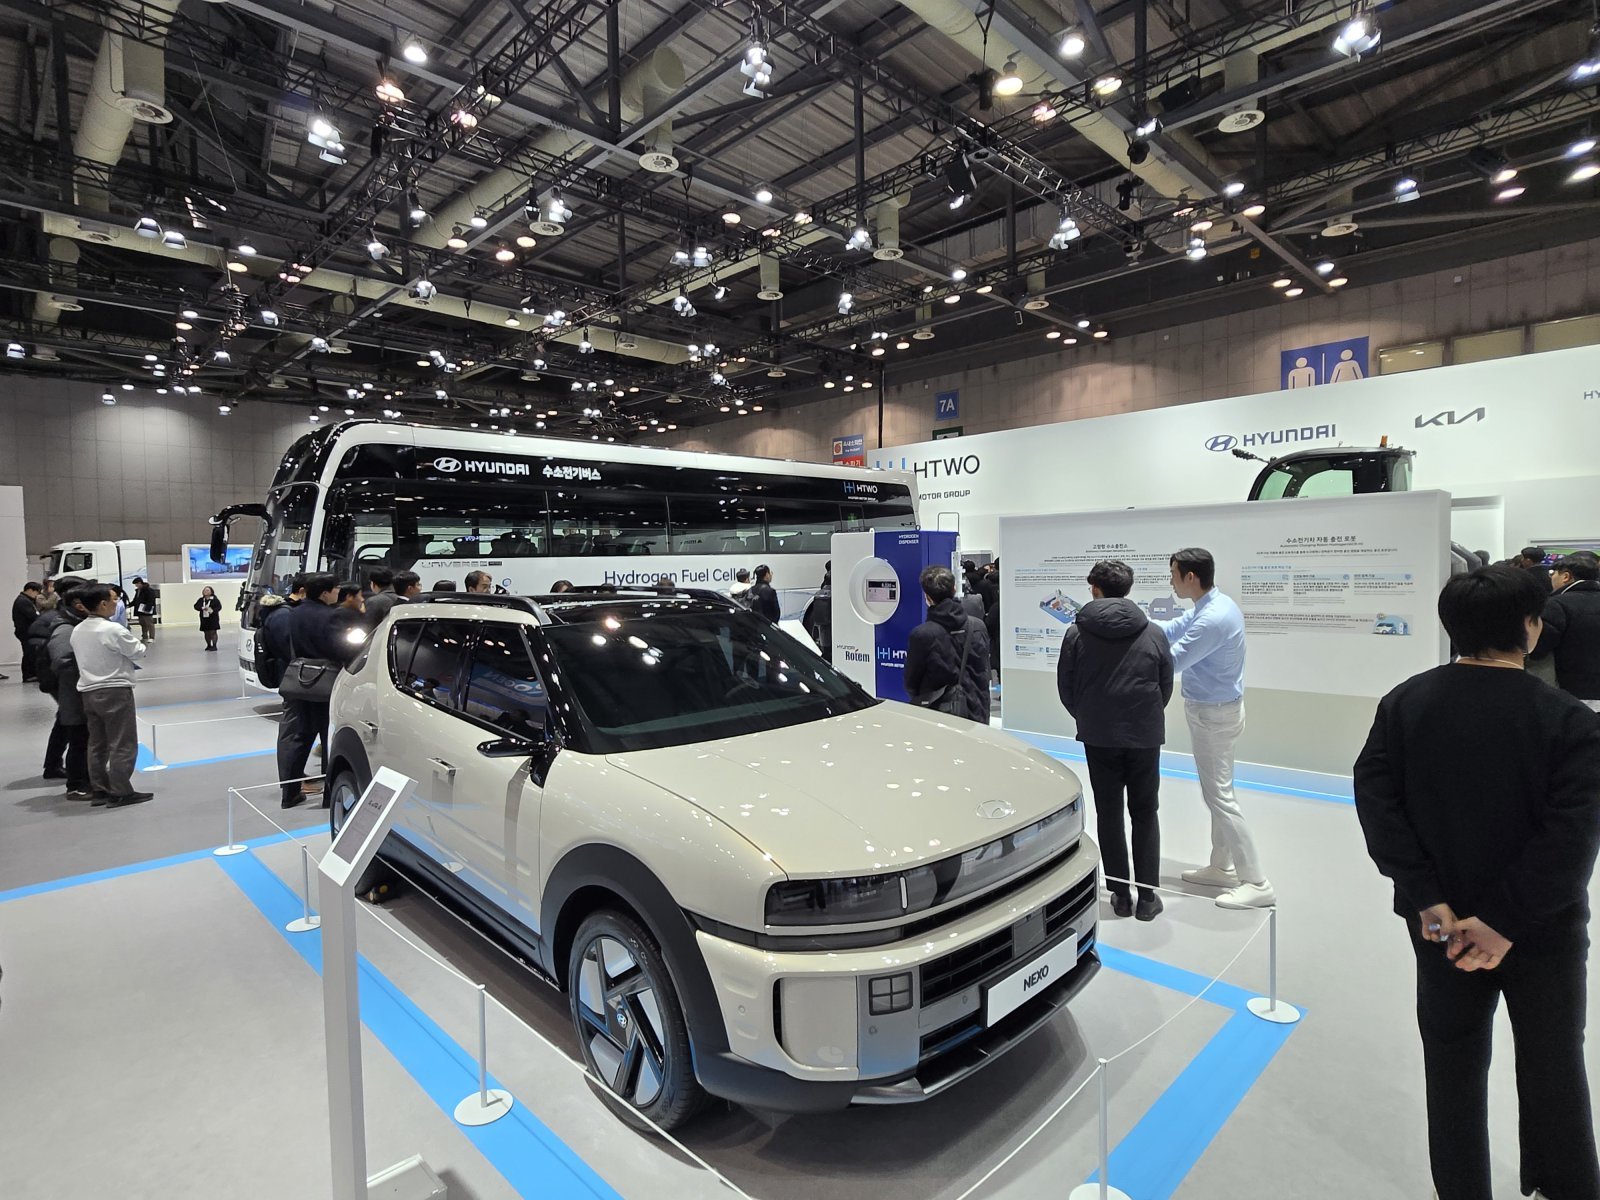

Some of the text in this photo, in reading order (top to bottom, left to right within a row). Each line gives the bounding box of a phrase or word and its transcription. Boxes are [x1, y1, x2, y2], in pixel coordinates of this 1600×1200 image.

[939, 398, 956, 413] 7A
[1415, 407, 1486, 429] KIA
[1243, 424, 1337, 447] HYUNDAI
[464, 460, 530, 476] HYUNDAI
[542, 464, 602, 481] 수소전기버스
[914, 455, 980, 479] HTWO
[856, 484, 878, 494] HTWO
[943, 489, 971, 499] GROUP
[604, 570, 677, 586] Hydrogen
[682, 568, 709, 583] Fuel
[713, 567, 736, 582] Cell
[845, 649, 870, 662] Rotem
[892, 650, 907, 659] HT
[1023, 965, 1049, 991] NEXO
